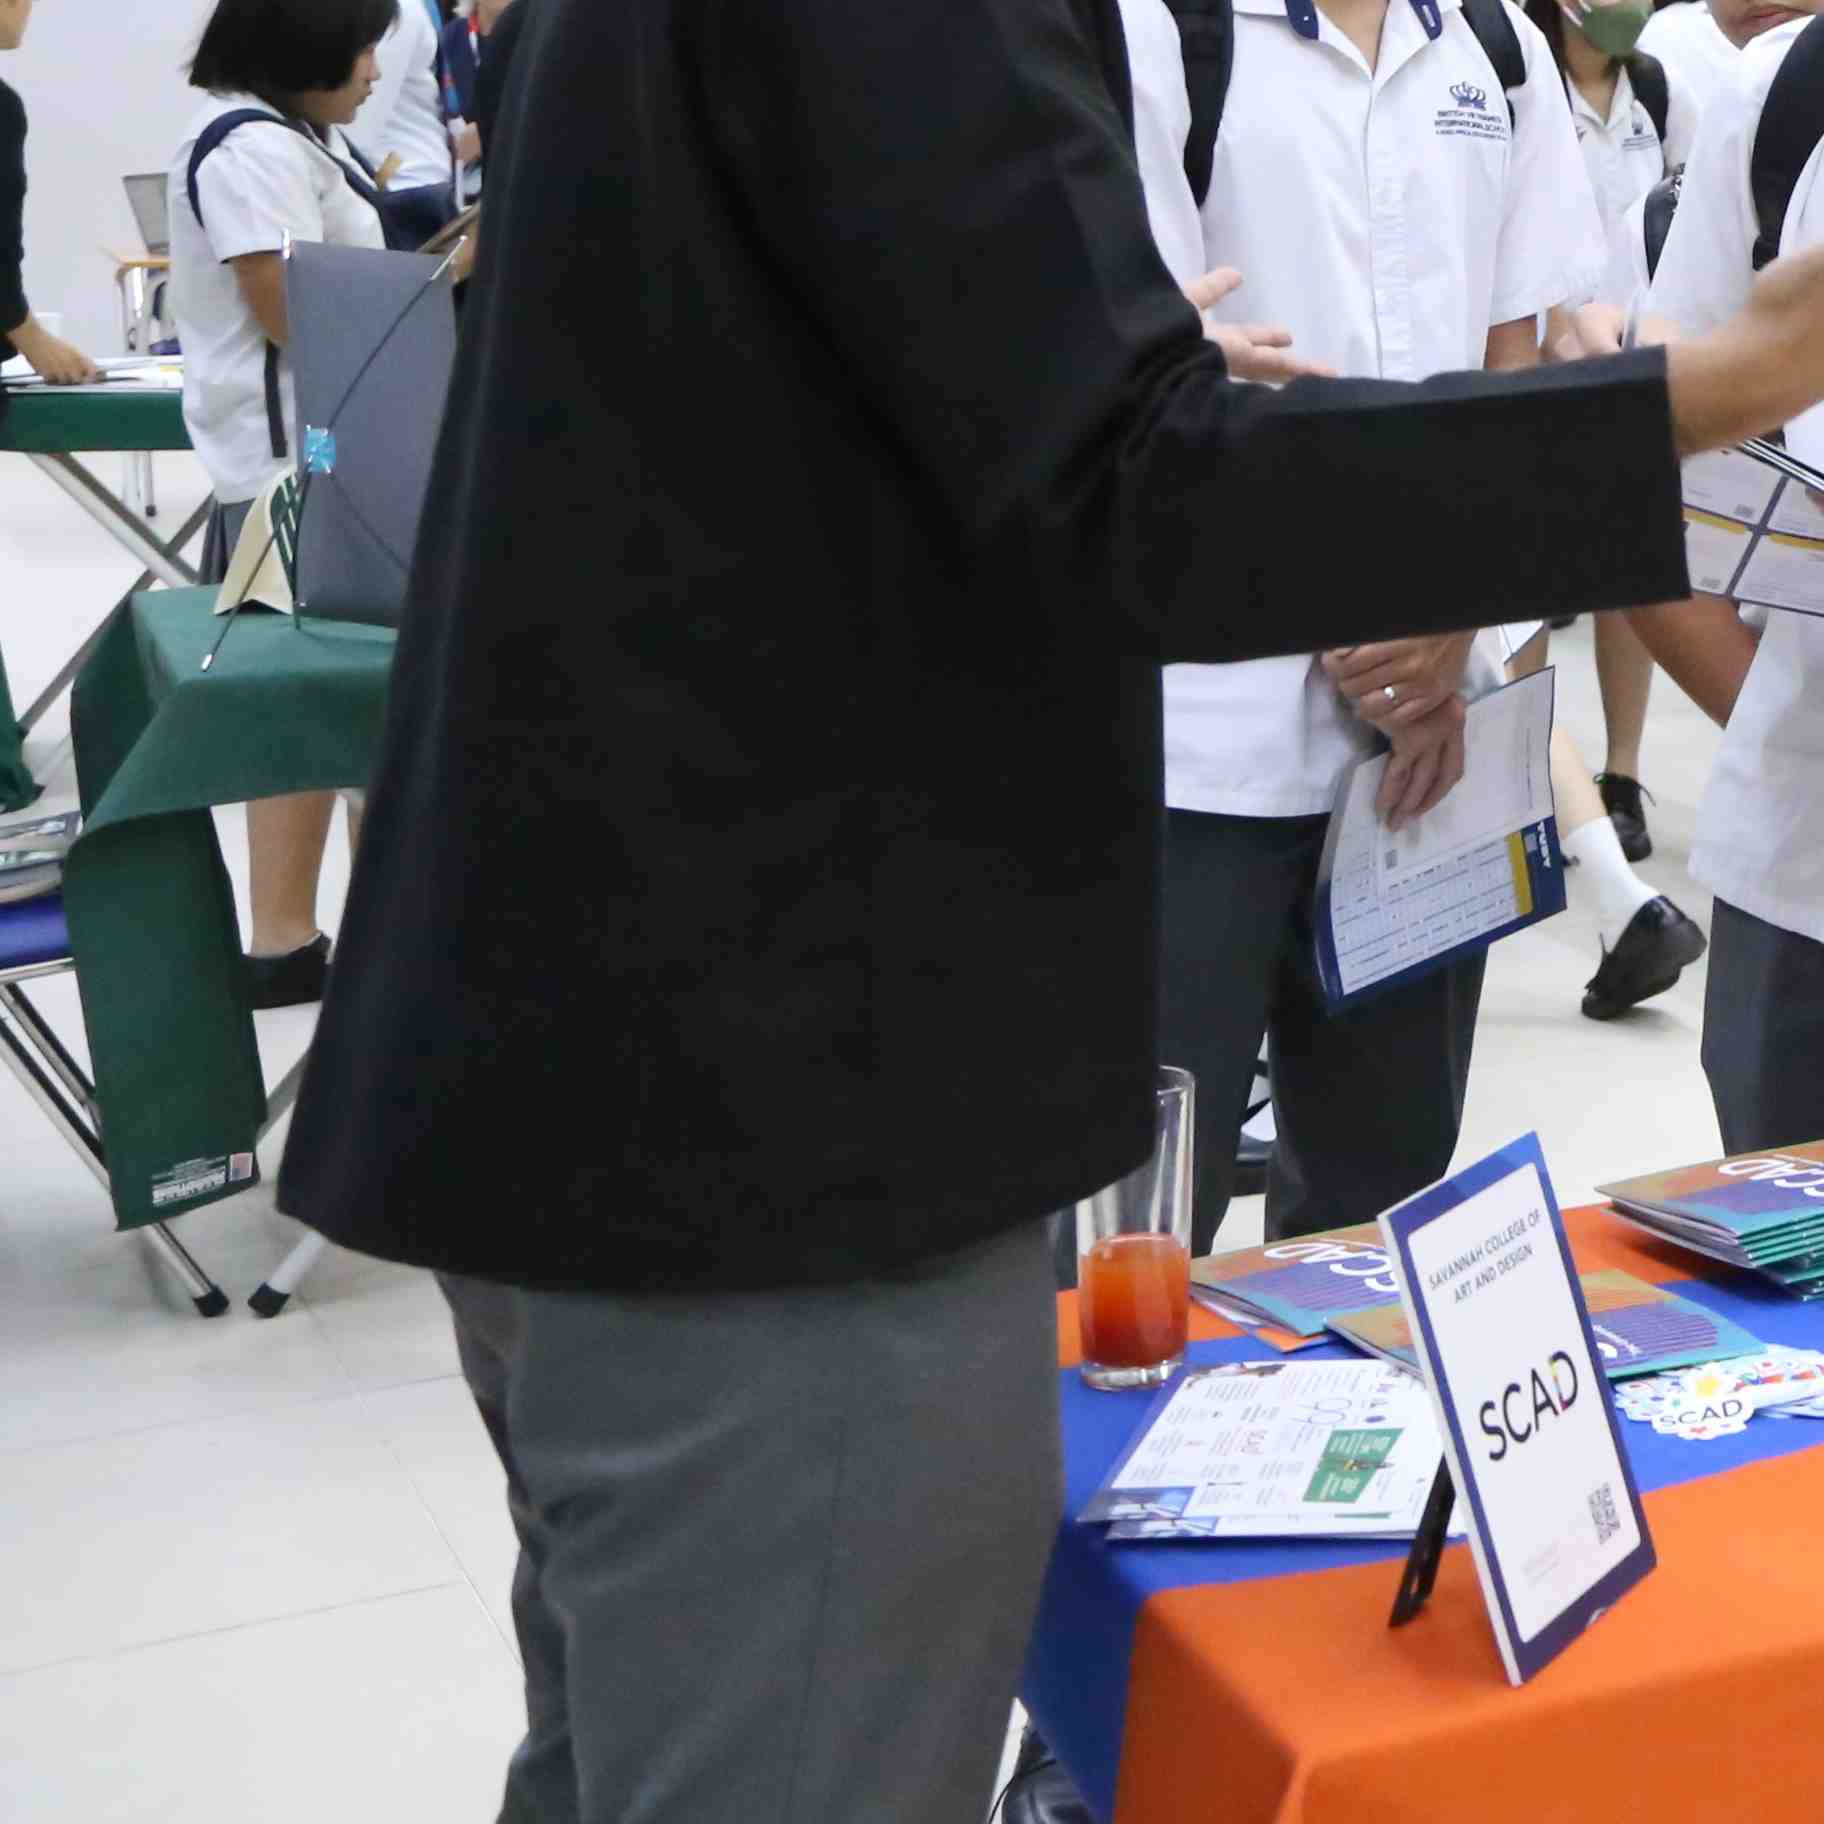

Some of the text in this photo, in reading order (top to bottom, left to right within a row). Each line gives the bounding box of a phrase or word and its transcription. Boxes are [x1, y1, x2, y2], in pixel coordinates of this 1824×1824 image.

[1537, 820, 1552, 869] TUDY
[1429, 1208, 1542, 1292] SAVANNAH COLLEGE OF
[1453, 1243, 1534, 1304] ART AND DESIGN
[1478, 1350, 1580, 1462] SCAD
[1659, 1398, 1744, 1430] SCAD
